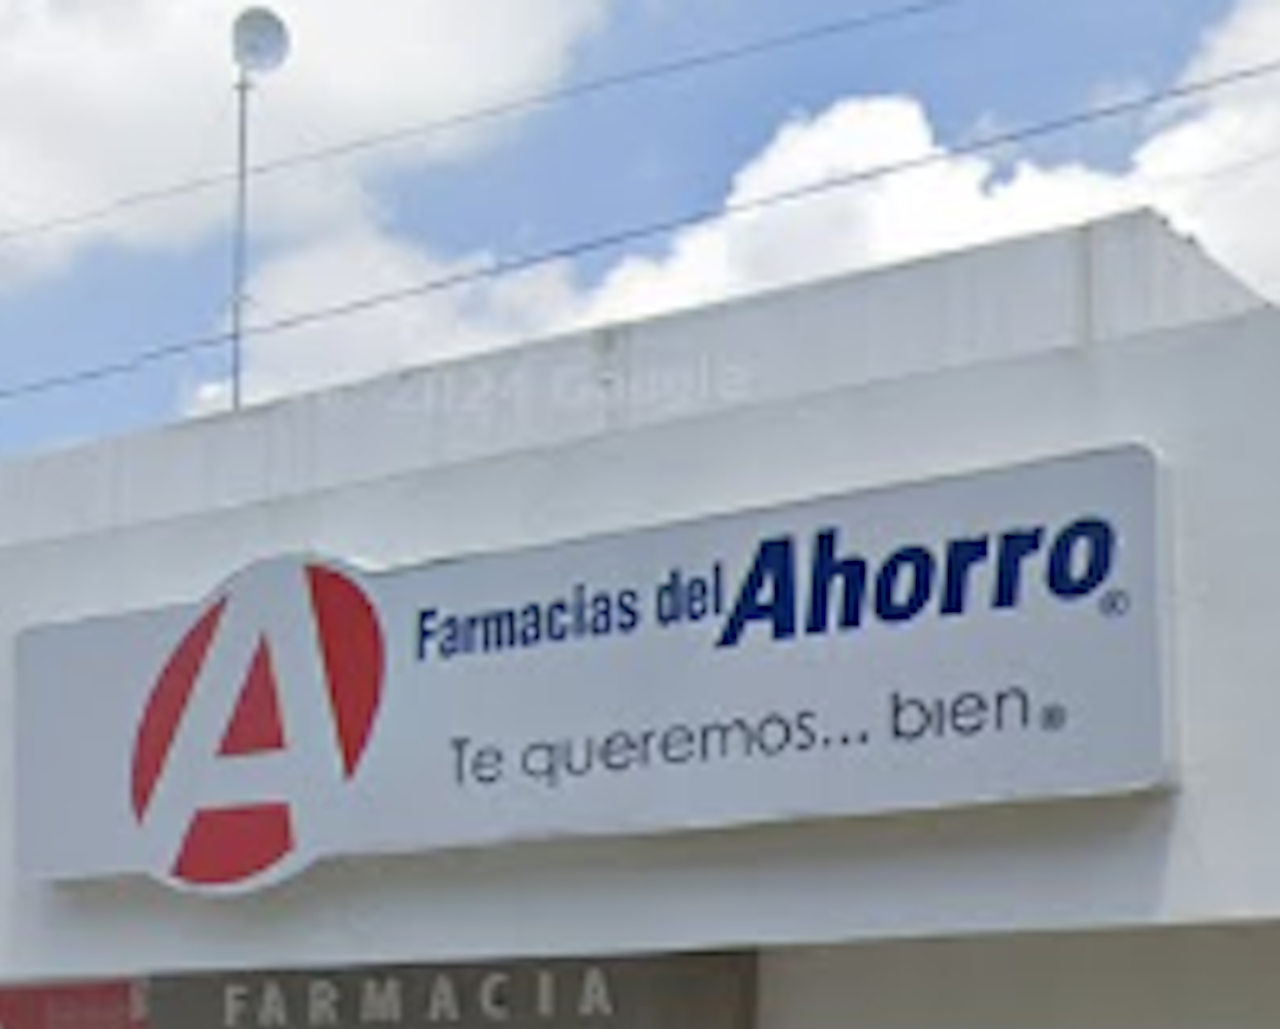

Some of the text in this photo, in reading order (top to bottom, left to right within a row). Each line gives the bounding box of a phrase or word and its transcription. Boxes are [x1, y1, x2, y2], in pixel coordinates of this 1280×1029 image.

[416, 580, 641, 661] Farmacias
[656, 558, 722, 628] del
[450, 736, 504, 785] Te
[520, 709, 870, 788] queremos...
[223, 966, 614, 1029] FARMACIA
